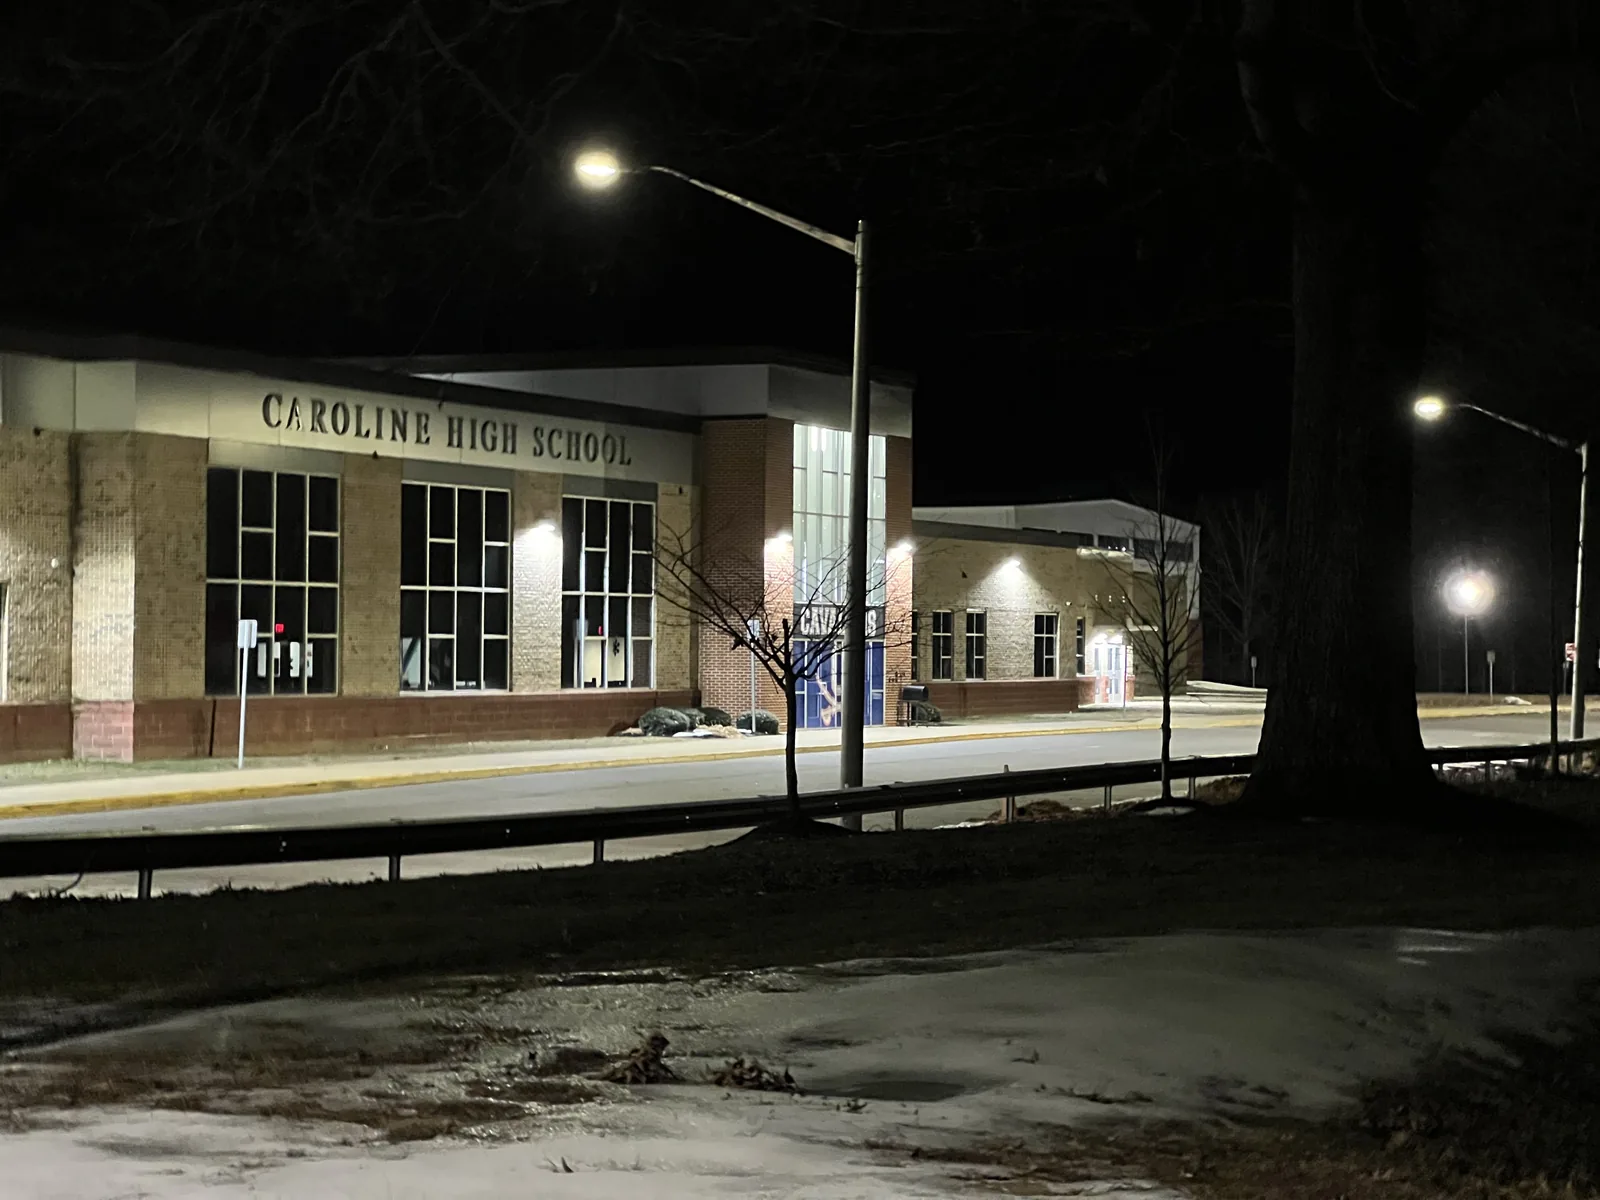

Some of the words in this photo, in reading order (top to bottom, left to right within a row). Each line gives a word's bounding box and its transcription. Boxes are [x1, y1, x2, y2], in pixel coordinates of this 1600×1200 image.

[262, 393, 431, 445] CAROLINE
[446, 415, 518, 455] HIGH
[533, 426, 632, 466] SCHOOL
